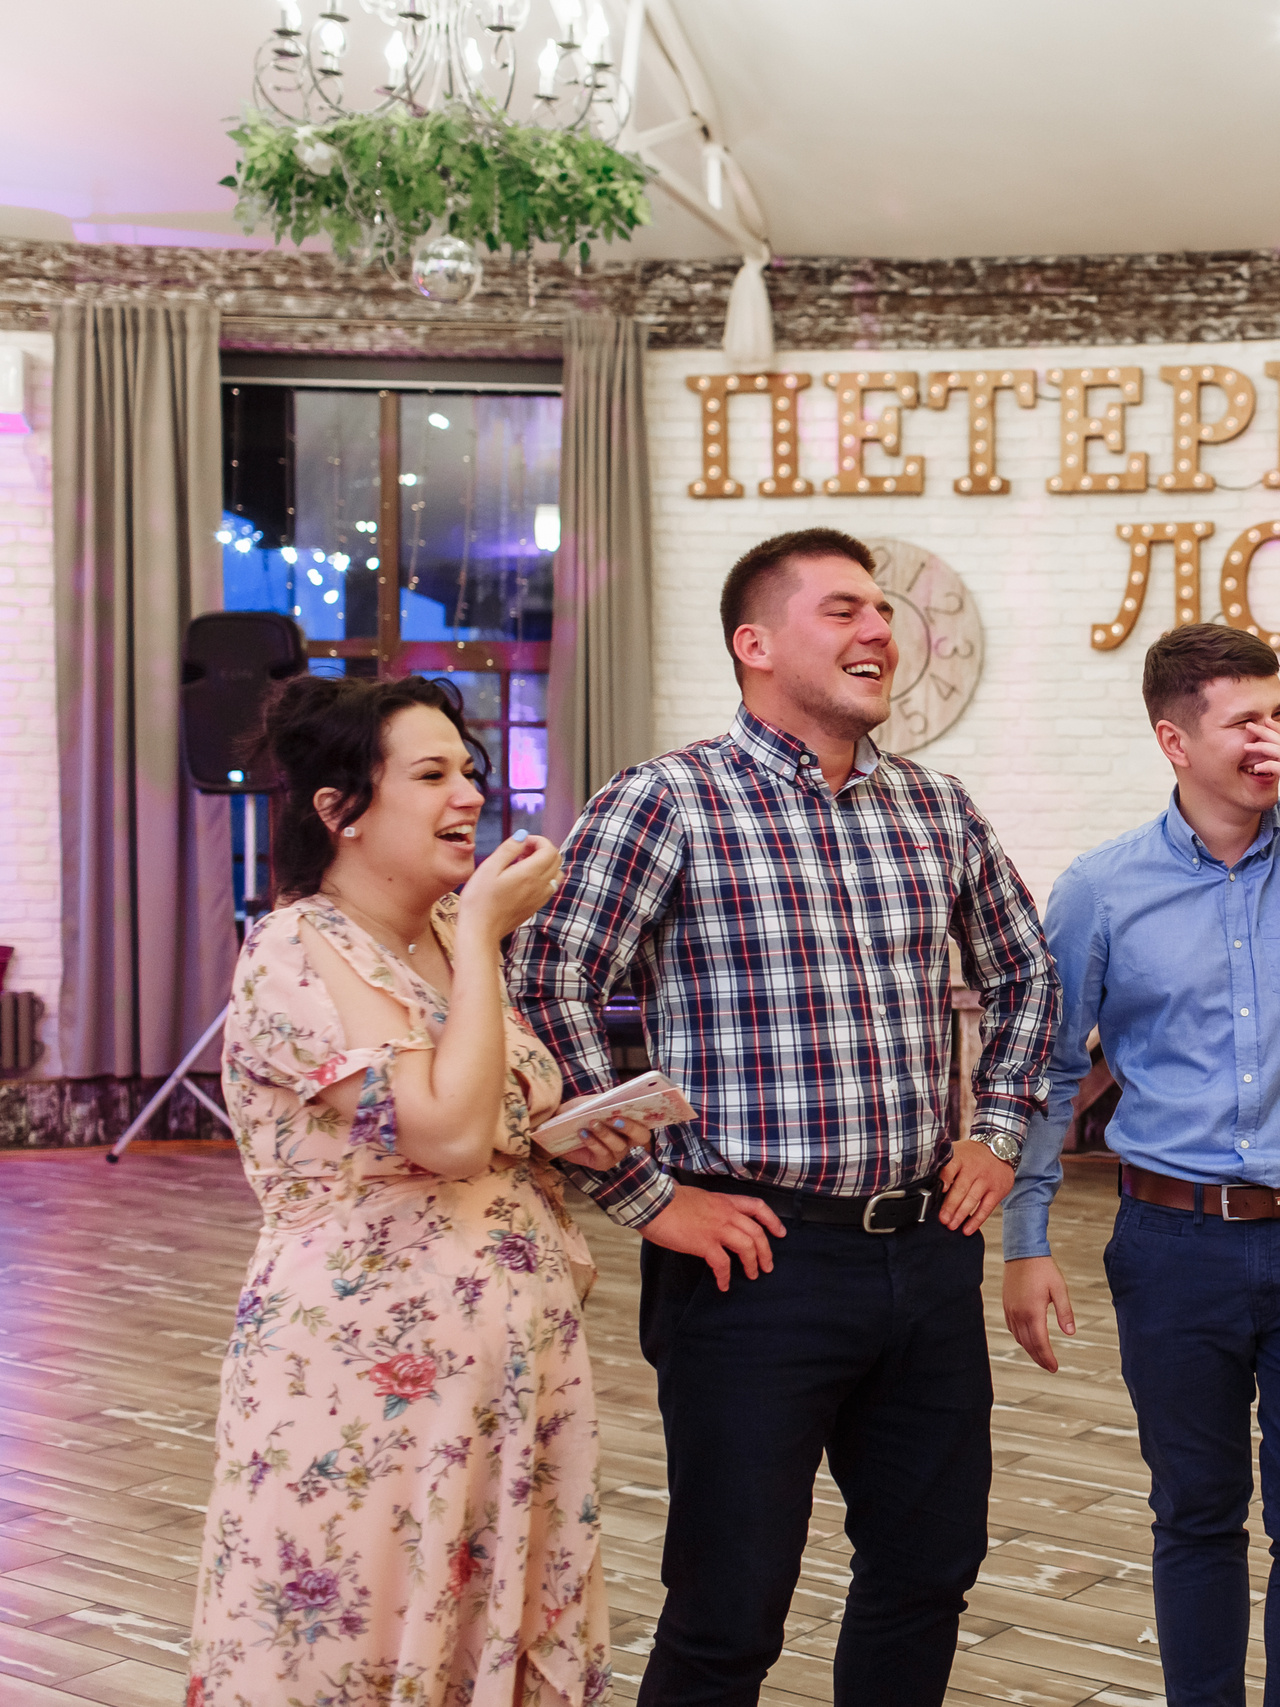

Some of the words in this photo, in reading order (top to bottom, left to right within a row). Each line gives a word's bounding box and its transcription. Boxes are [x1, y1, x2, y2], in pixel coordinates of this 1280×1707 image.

[924, 591, 965, 626] 2
[934, 636, 975, 660] 3
[899, 697, 929, 736] 5
